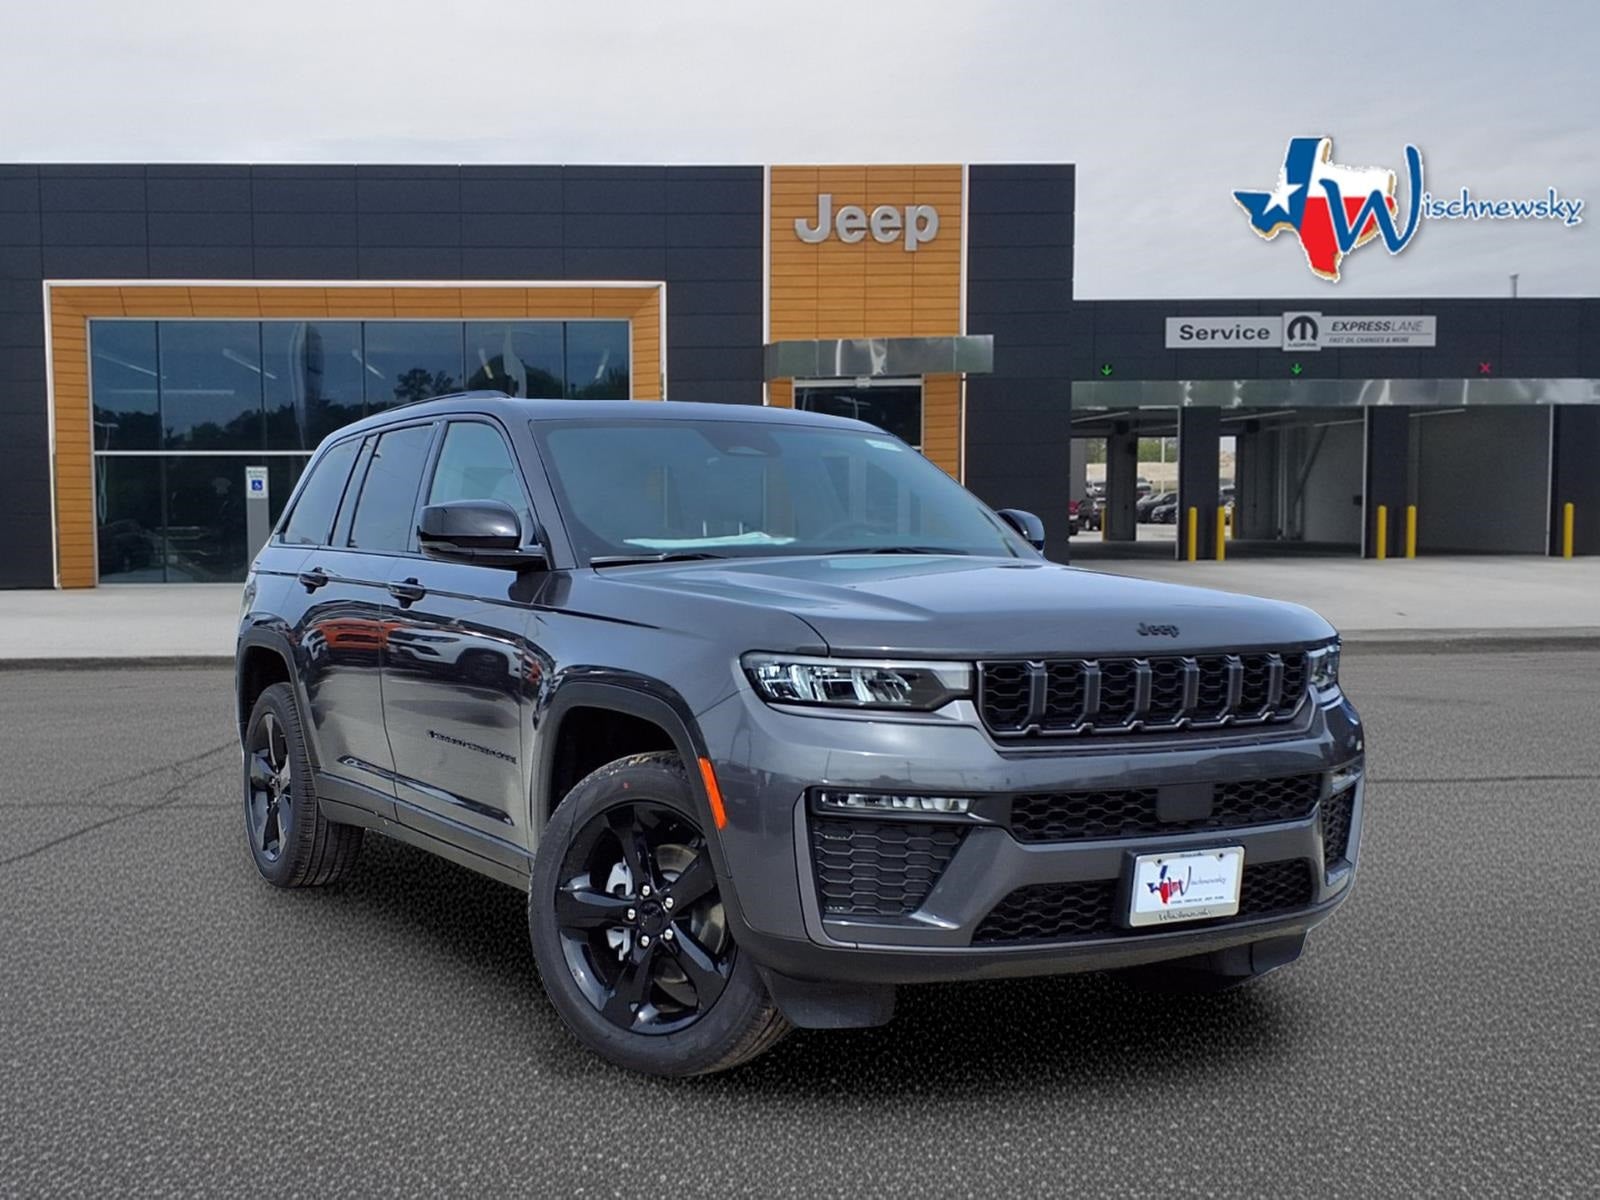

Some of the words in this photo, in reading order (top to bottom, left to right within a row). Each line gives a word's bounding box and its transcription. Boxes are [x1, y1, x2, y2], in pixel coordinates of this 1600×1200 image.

[794, 193, 939, 252] Jeep
[1179, 323, 1271, 341] Service
[1136, 622, 1180, 639] Jeep
